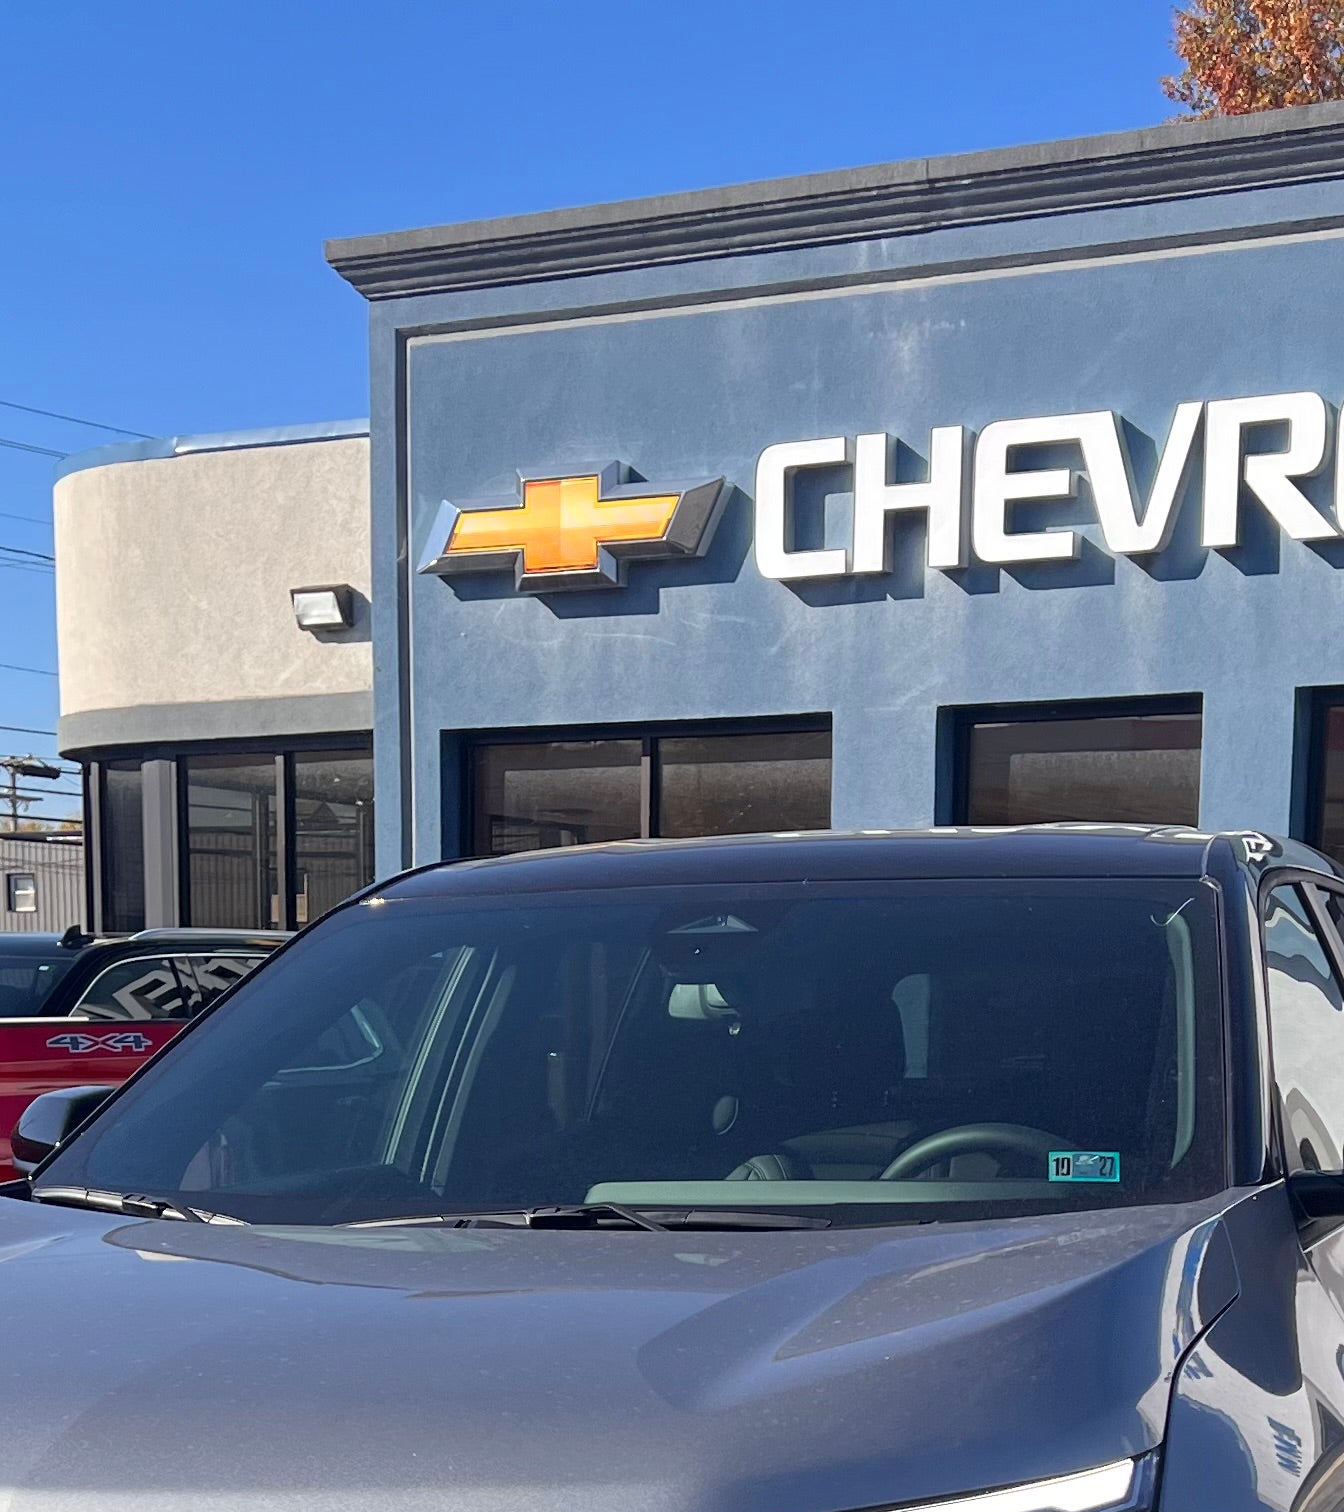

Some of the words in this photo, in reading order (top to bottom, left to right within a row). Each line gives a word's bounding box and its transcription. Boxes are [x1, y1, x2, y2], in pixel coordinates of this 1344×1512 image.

[46, 1032, 153, 1053] 4X4
[1052, 1157, 1071, 1176] 10
[1099, 1156, 1115, 1176] 27
